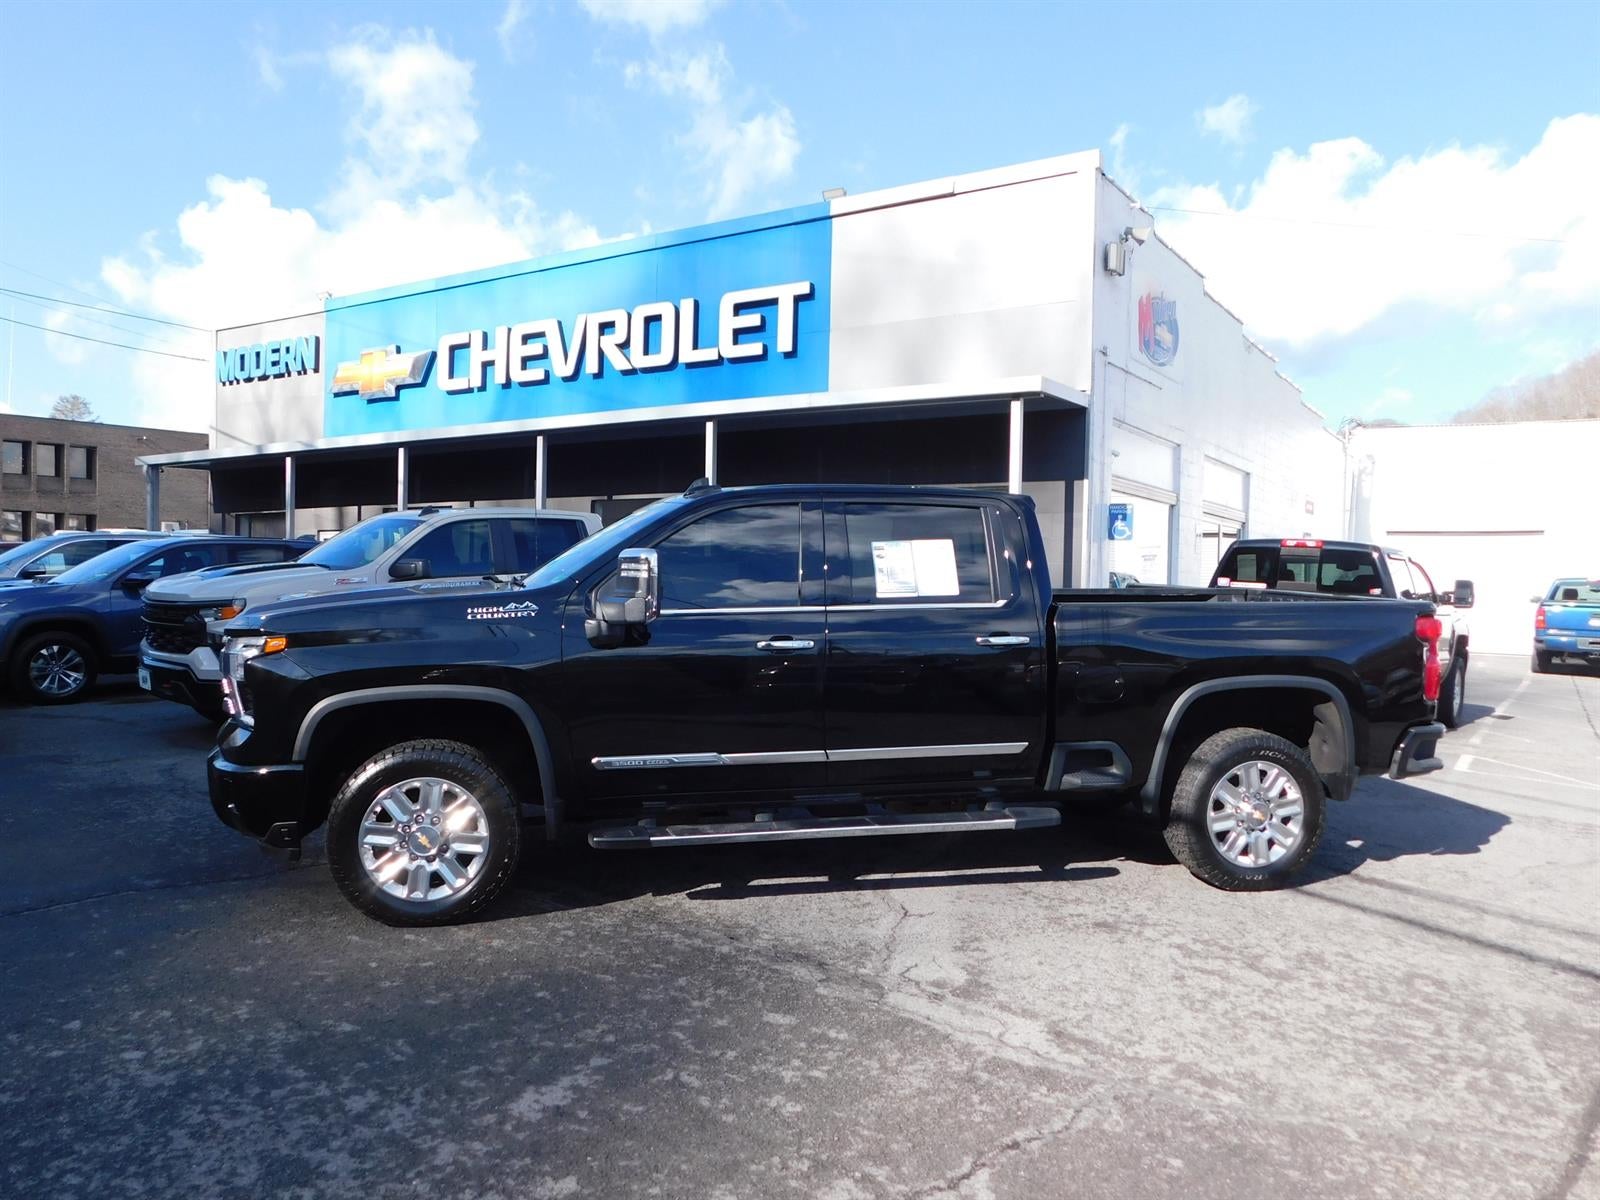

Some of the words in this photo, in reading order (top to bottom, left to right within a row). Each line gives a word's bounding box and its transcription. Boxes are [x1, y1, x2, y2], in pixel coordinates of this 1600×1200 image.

[437, 281, 813, 393] CHEVROLET
[216, 336, 319, 386] MODERN
[467, 606, 504, 614] HIGH
[467, 610, 538, 620] COUNTRY
